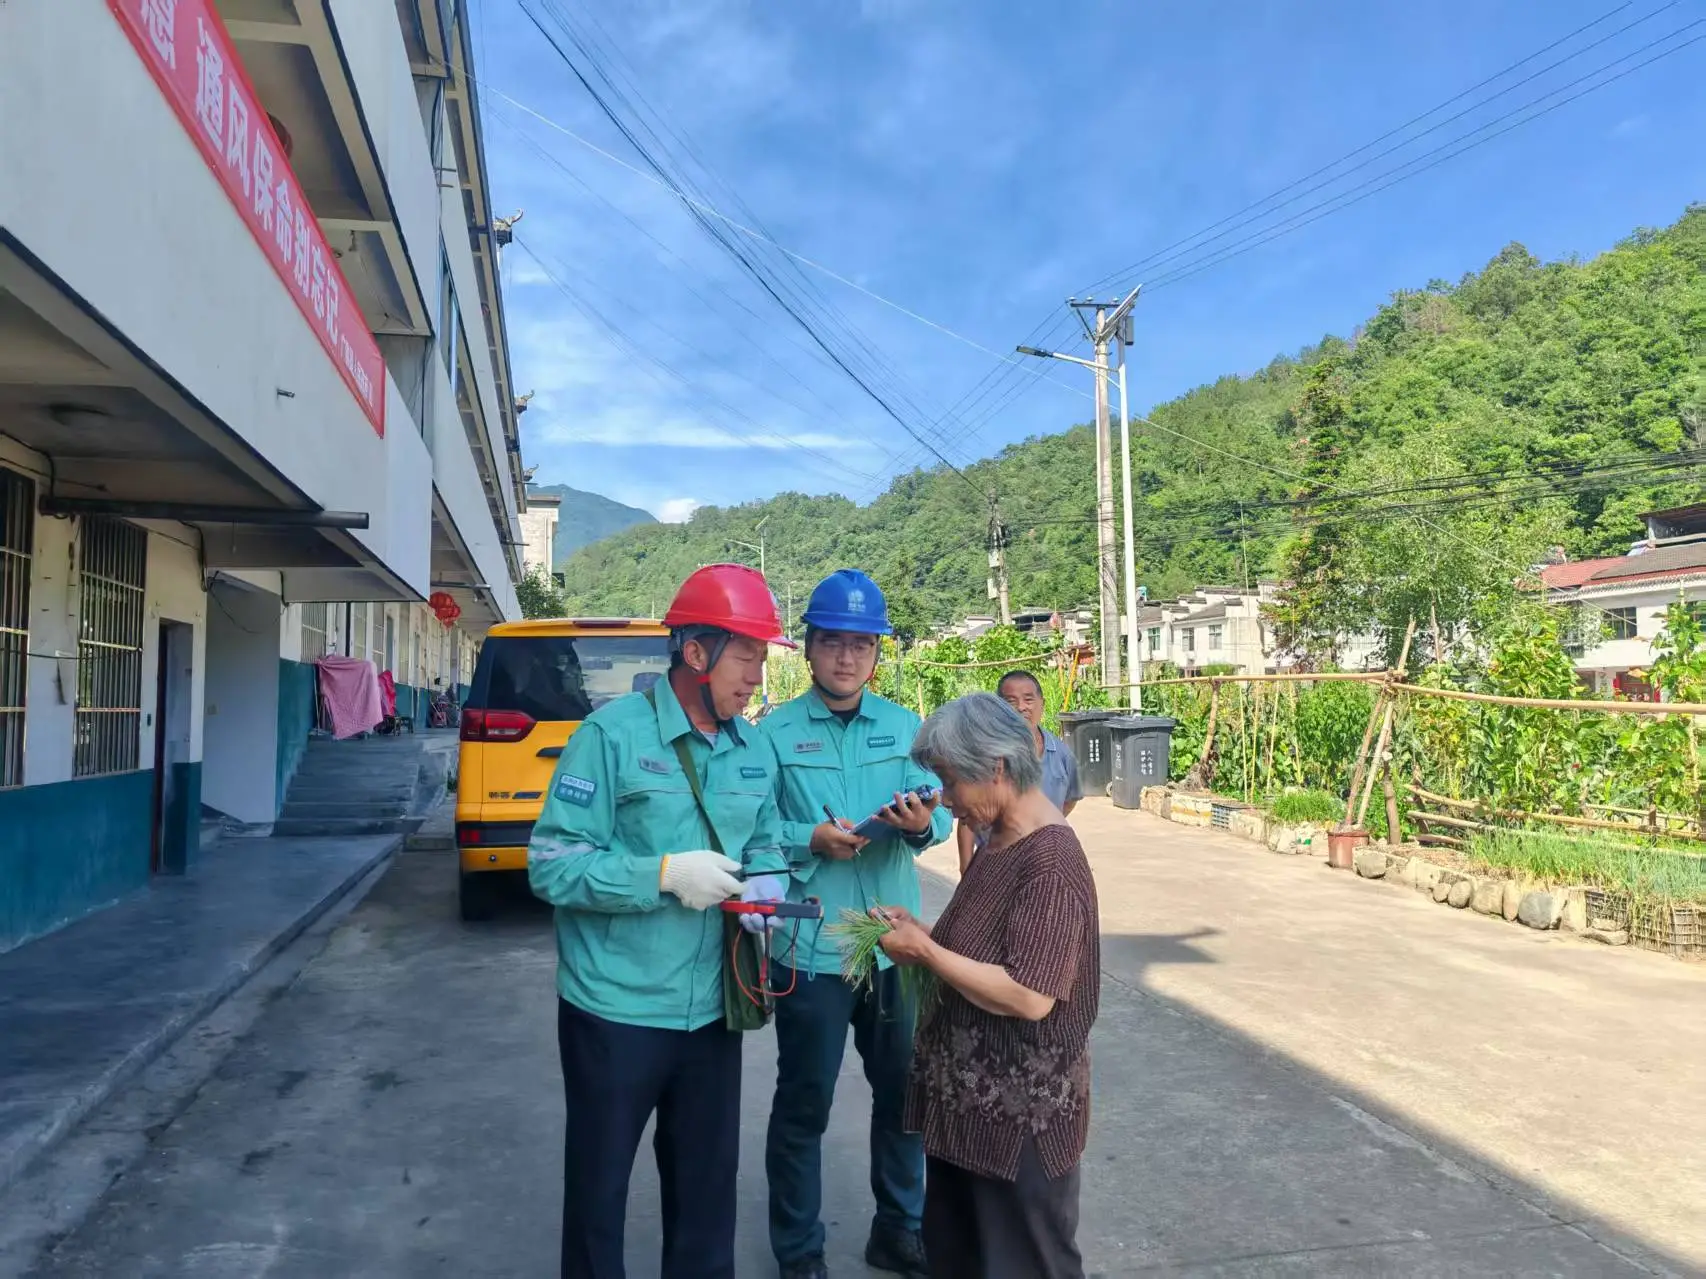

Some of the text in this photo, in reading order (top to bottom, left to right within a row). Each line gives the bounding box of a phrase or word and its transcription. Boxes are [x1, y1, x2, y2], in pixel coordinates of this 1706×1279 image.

[196, 17, 339, 345] 通风保命别忘记
